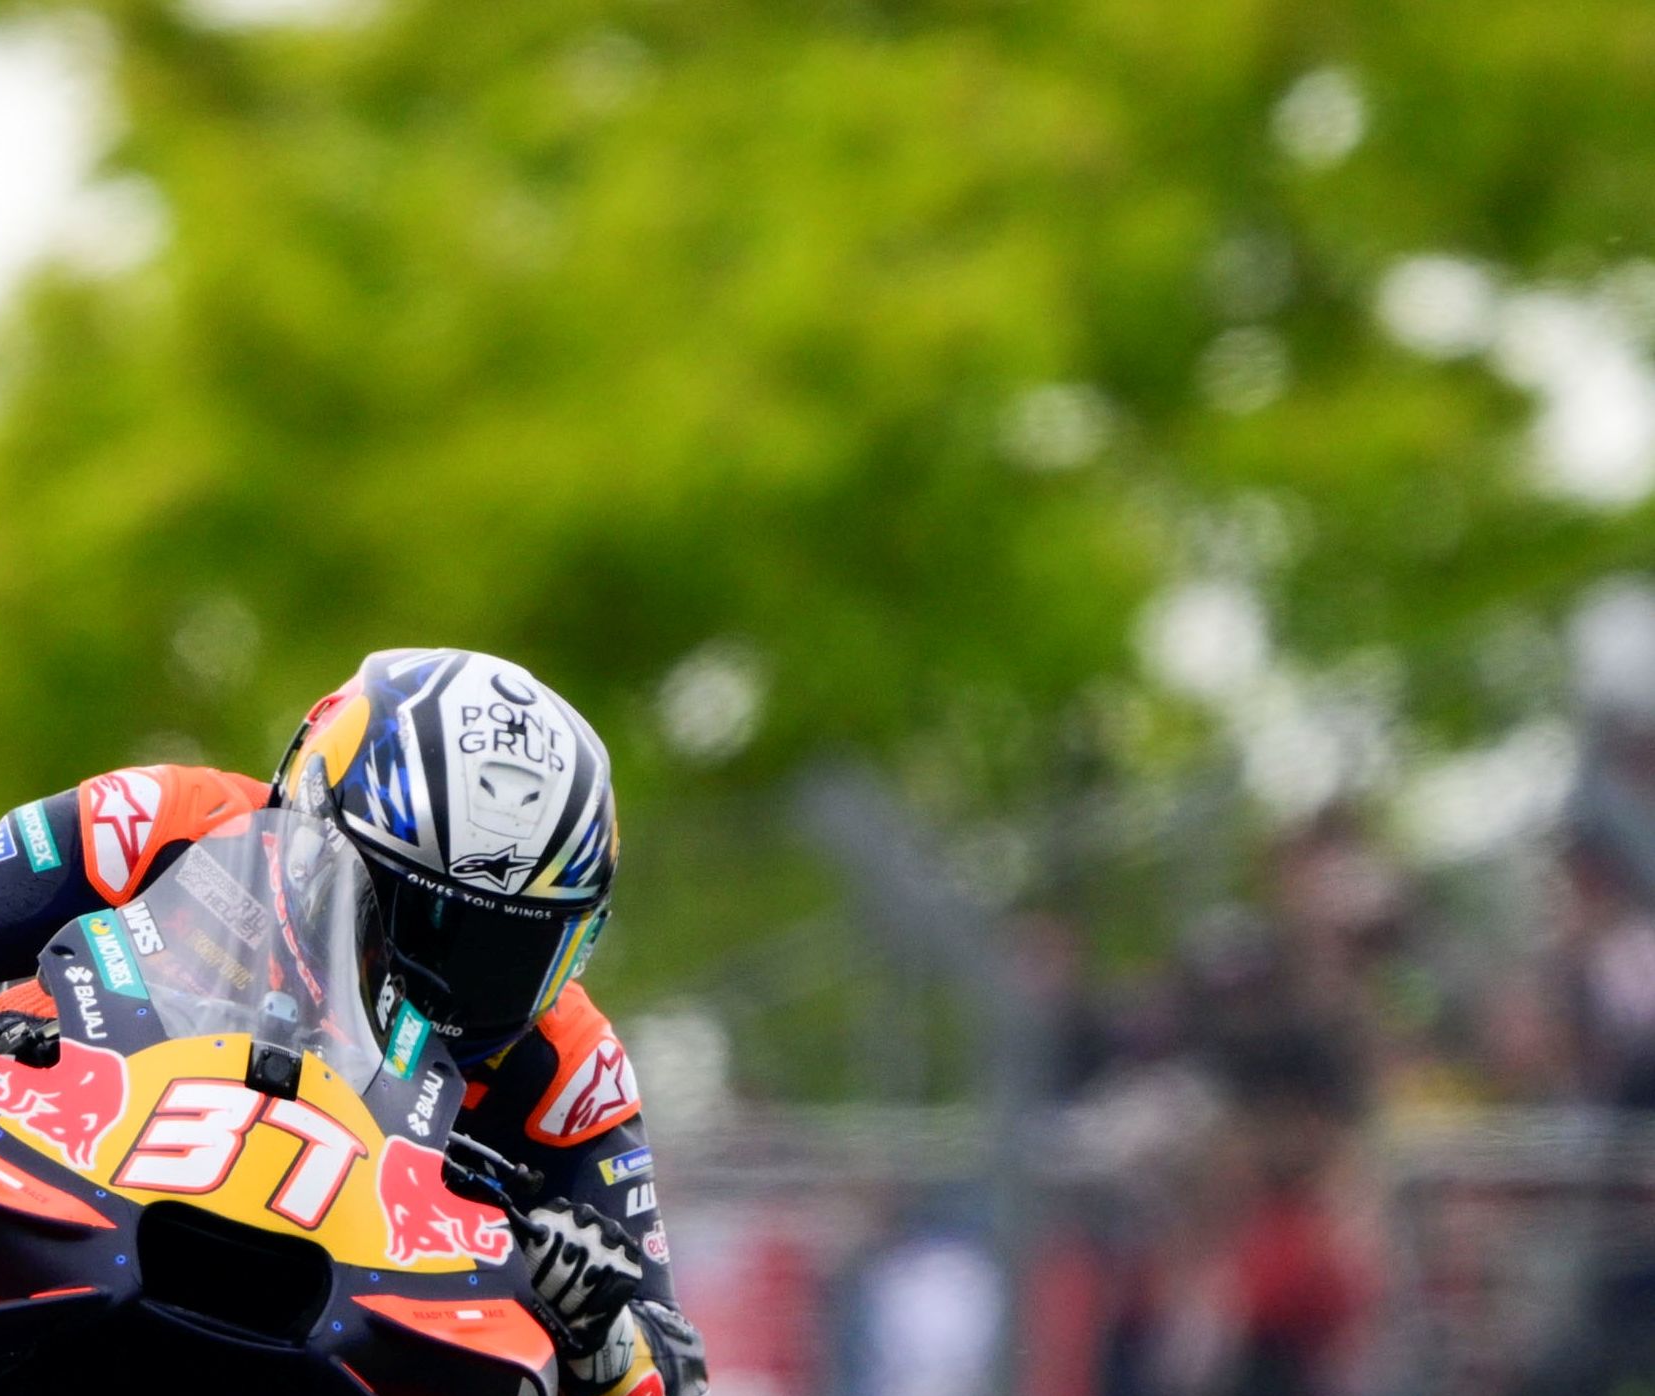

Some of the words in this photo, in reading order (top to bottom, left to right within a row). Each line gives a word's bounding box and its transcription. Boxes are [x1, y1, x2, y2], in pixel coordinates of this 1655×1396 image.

[459, 729, 565, 773] GRUP
[460, 702, 563, 749] PONT
[406, 873, 454, 897] GIVES
[463, 893, 496, 910] YOU
[503, 904, 553, 920] WINGS
[121, 900, 166, 956] WRS
[94, 932, 134, 989] MOTOREX
[74, 984, 108, 1040] BAJAJ
[415, 1070, 444, 1120] BAJAJ
[109, 1077, 368, 1231] 37
